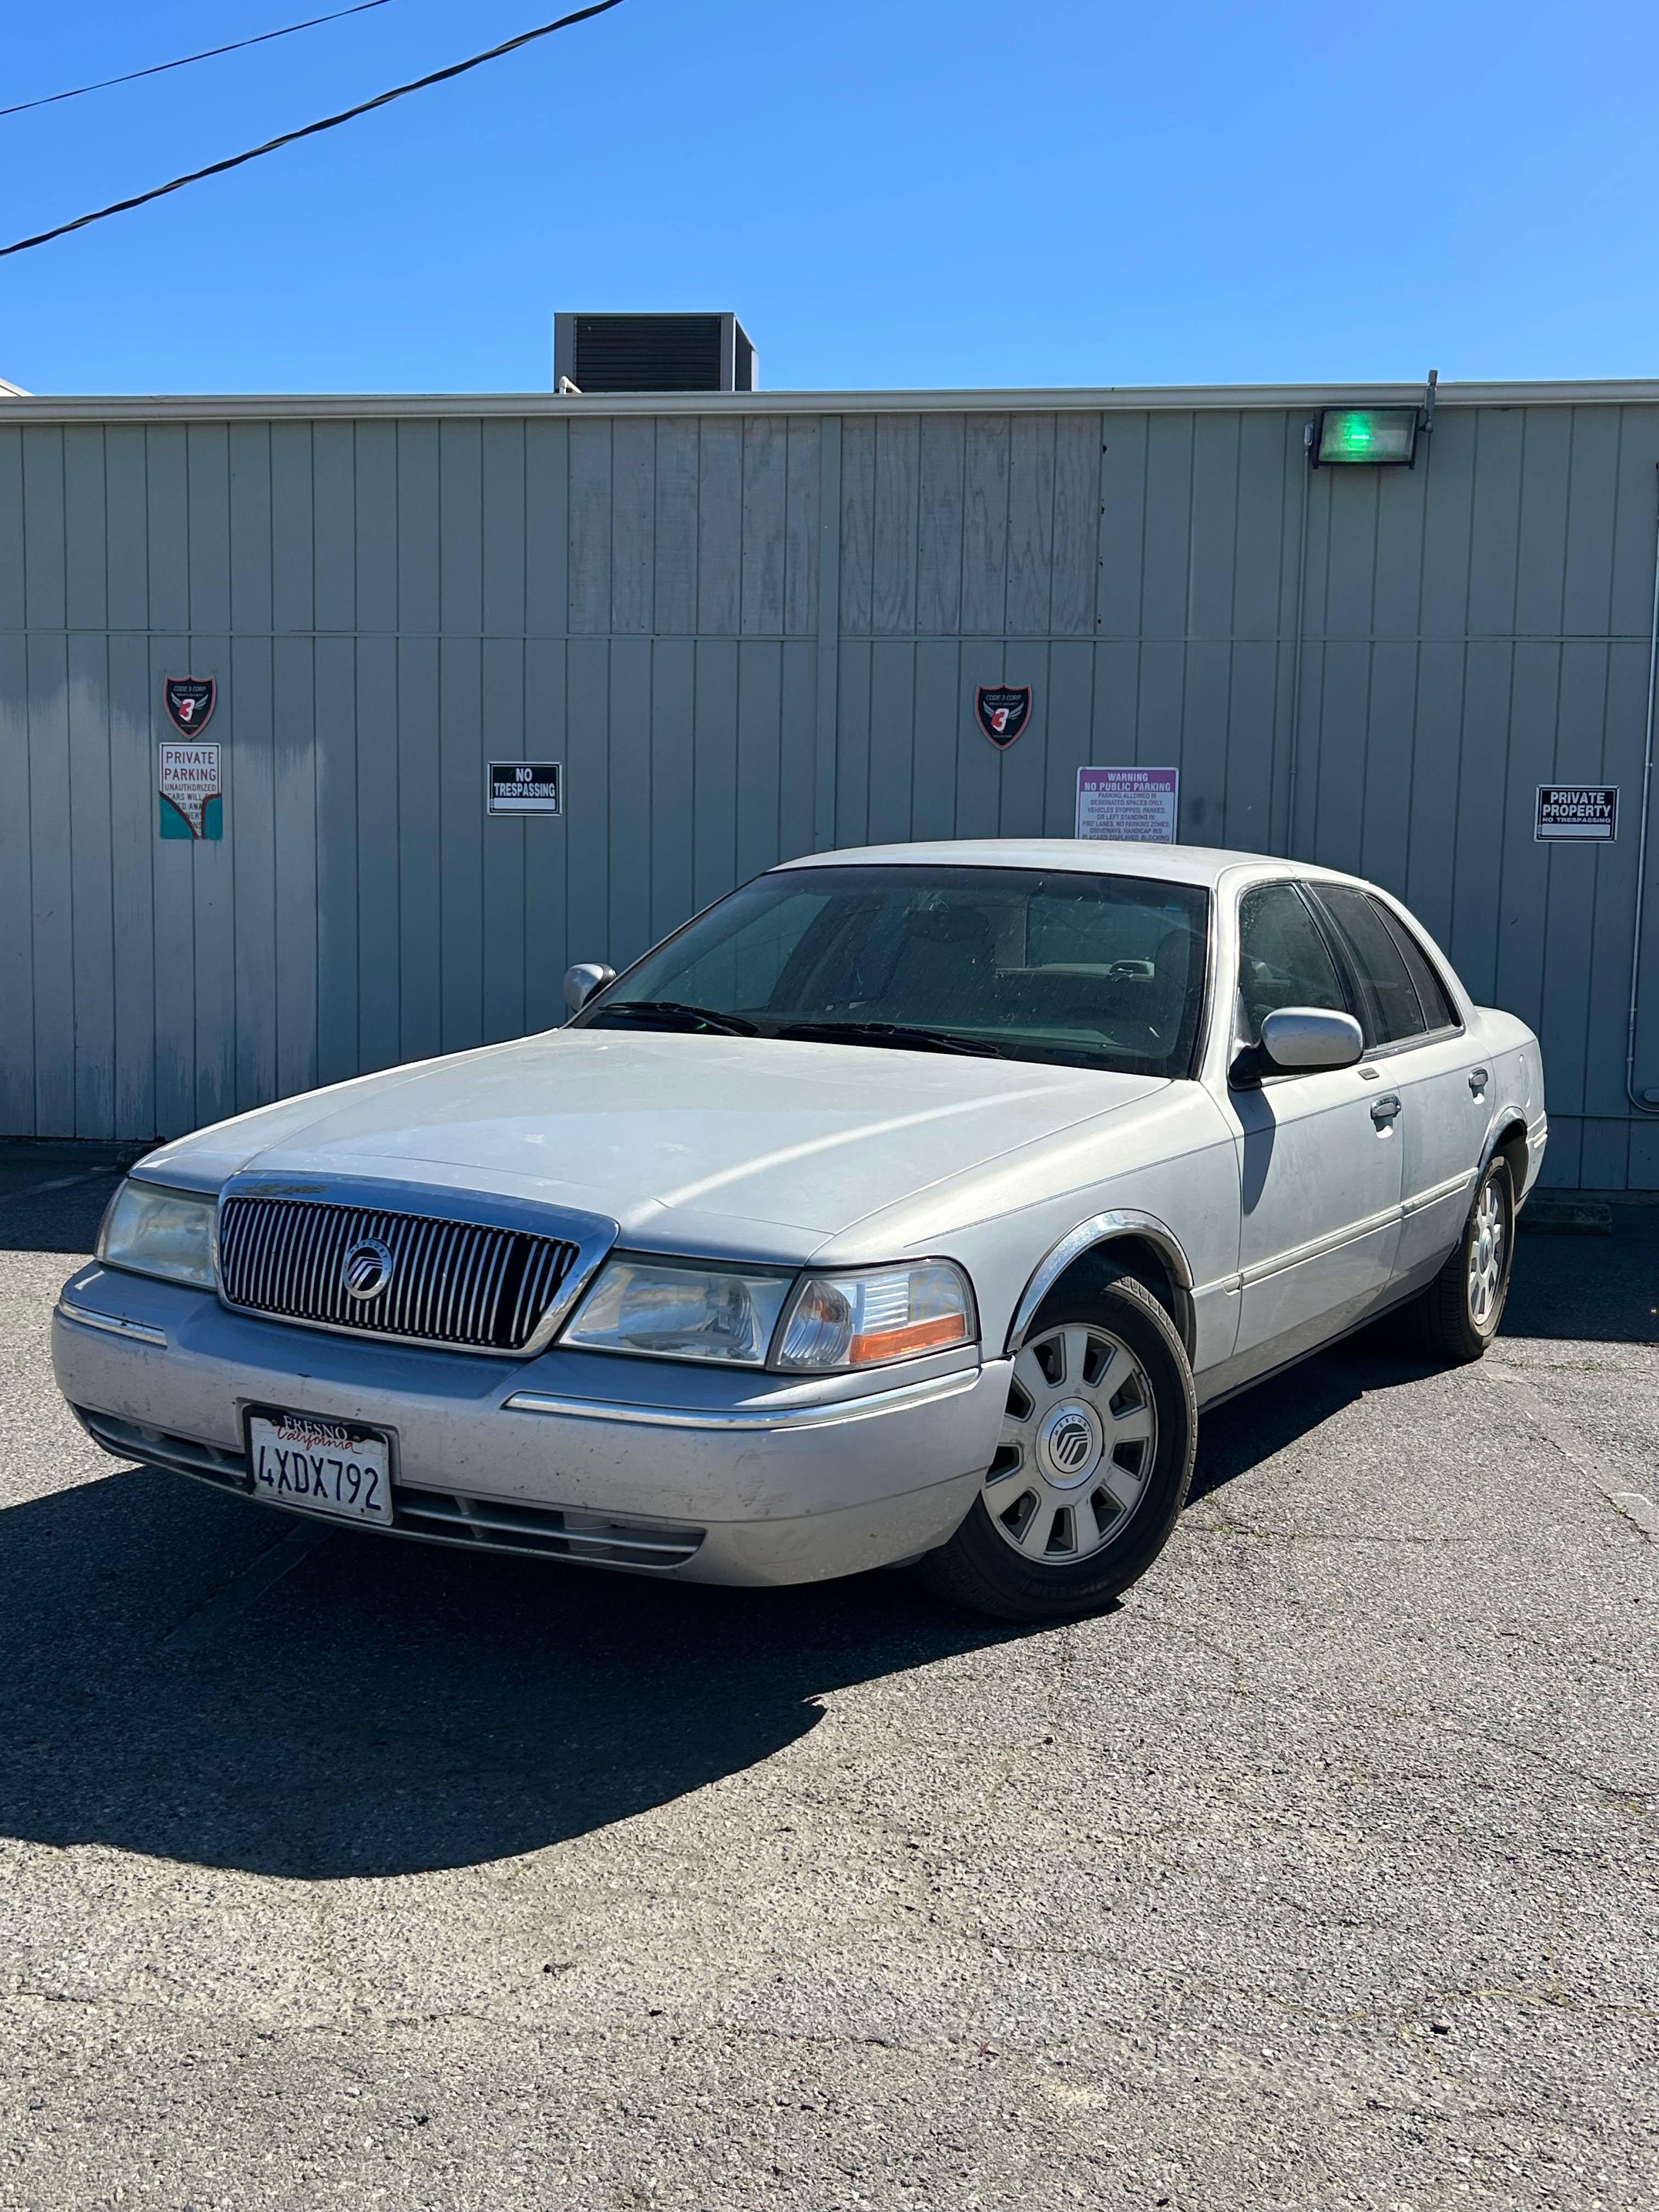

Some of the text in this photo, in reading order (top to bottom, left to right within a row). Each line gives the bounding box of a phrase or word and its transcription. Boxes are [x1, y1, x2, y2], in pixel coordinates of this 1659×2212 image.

[166, 752, 215, 764] PRIVATE
[165, 769, 216, 781] PARKING
[516, 768, 533, 782] NO
[1107, 772, 1148, 782] WARNING
[494, 783, 555, 797] TRESPASSING
[1084, 782, 1171, 792] NO PUBLIC PARKING
[1550, 792, 1605, 804] PRIVATE
[1542, 804, 1611, 817] PROPERTY
[283, 1415, 348, 1441] FRESNO
[1054, 1417, 1090, 1436] MERCURY
[278, 1426, 363, 1454] California
[259, 1446, 381, 1510] 4XDX792
